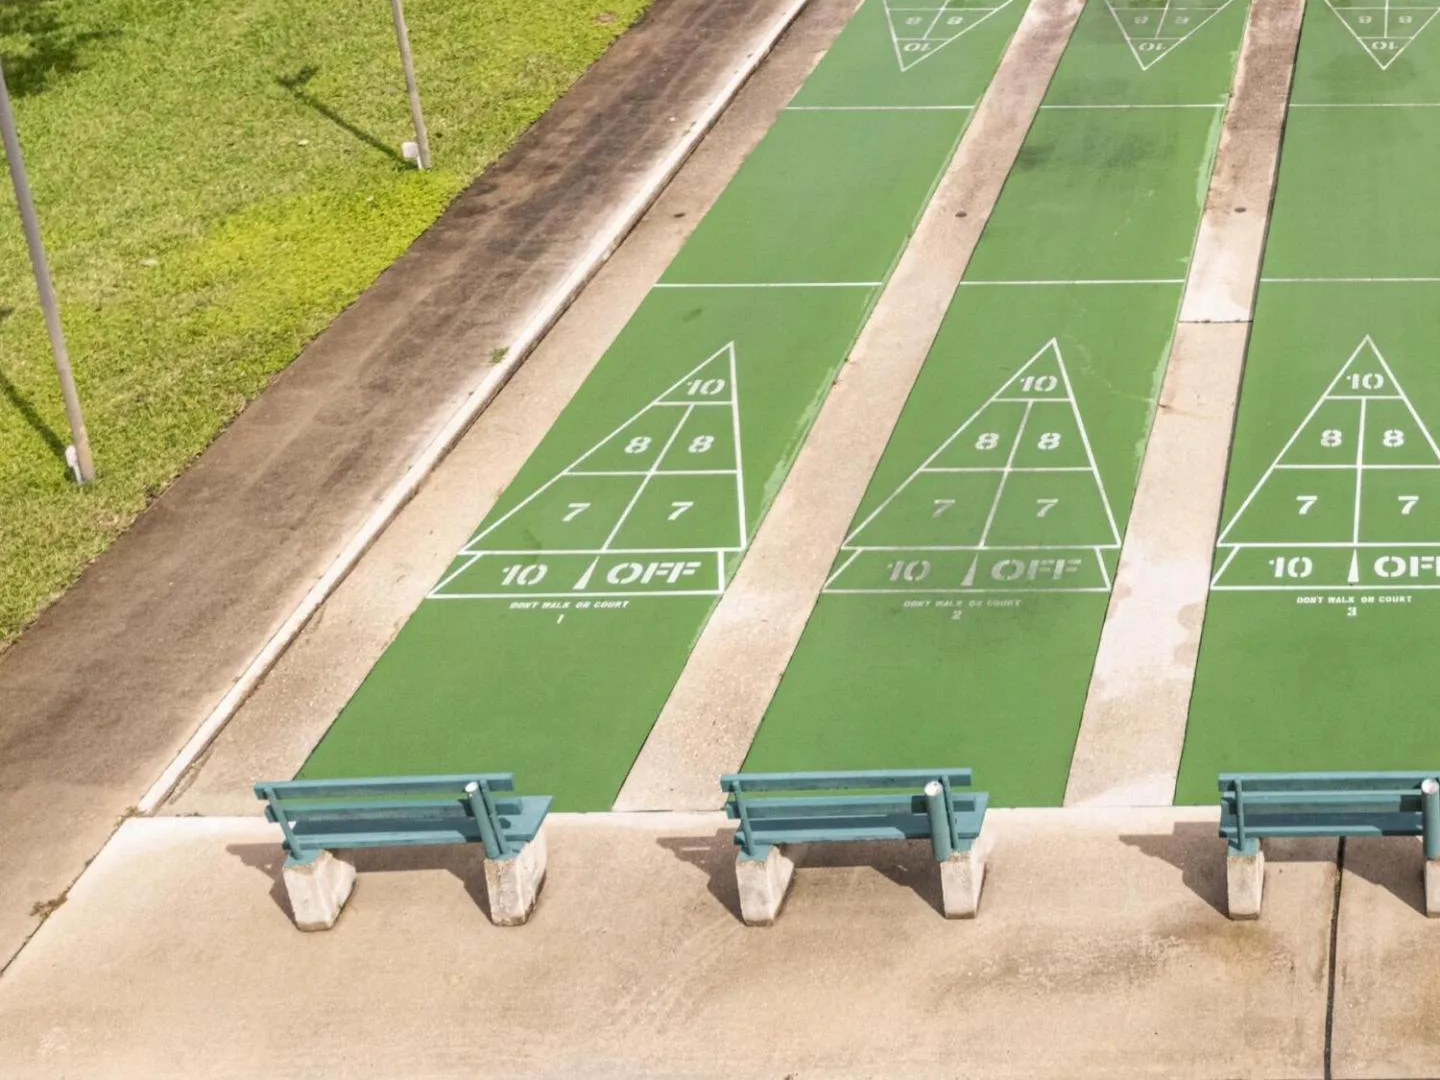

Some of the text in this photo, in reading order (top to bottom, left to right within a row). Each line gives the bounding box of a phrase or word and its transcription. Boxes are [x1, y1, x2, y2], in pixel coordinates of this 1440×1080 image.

[904, 43, 930, 52] 10
[1139, 43, 1166, 51] 10
[1372, 41, 1399, 50] 10
[686, 379, 725, 395] 10
[1019, 376, 1057, 392] 10
[1346, 373, 1384, 390] 10
[625, 437, 651, 454] 8
[688, 436, 713, 453] 8
[975, 433, 999, 450] 8
[1037, 432, 1060, 449] 8
[1320, 429, 1342, 447] 8
[1382, 429, 1404, 447] 8
[561, 502, 590, 522] 7
[667, 501, 693, 521] 7
[932, 500, 955, 518] 7
[1036, 499, 1058, 518] 7
[1296, 496, 1318, 515] 7
[1399, 496, 1419, 515] 7
[501, 561, 701, 585] 10 OFF
[887, 559, 1082, 581] 10 OFF
[1269, 557, 1313, 577] 10
[542, 601, 569, 609] WALK
[594, 600, 629, 608] COURT
[1379, 595, 1412, 603] COURT
[557, 614, 564, 624] 1
[952, 610, 962, 619] 2
[1347, 607, 1357, 616] 3
